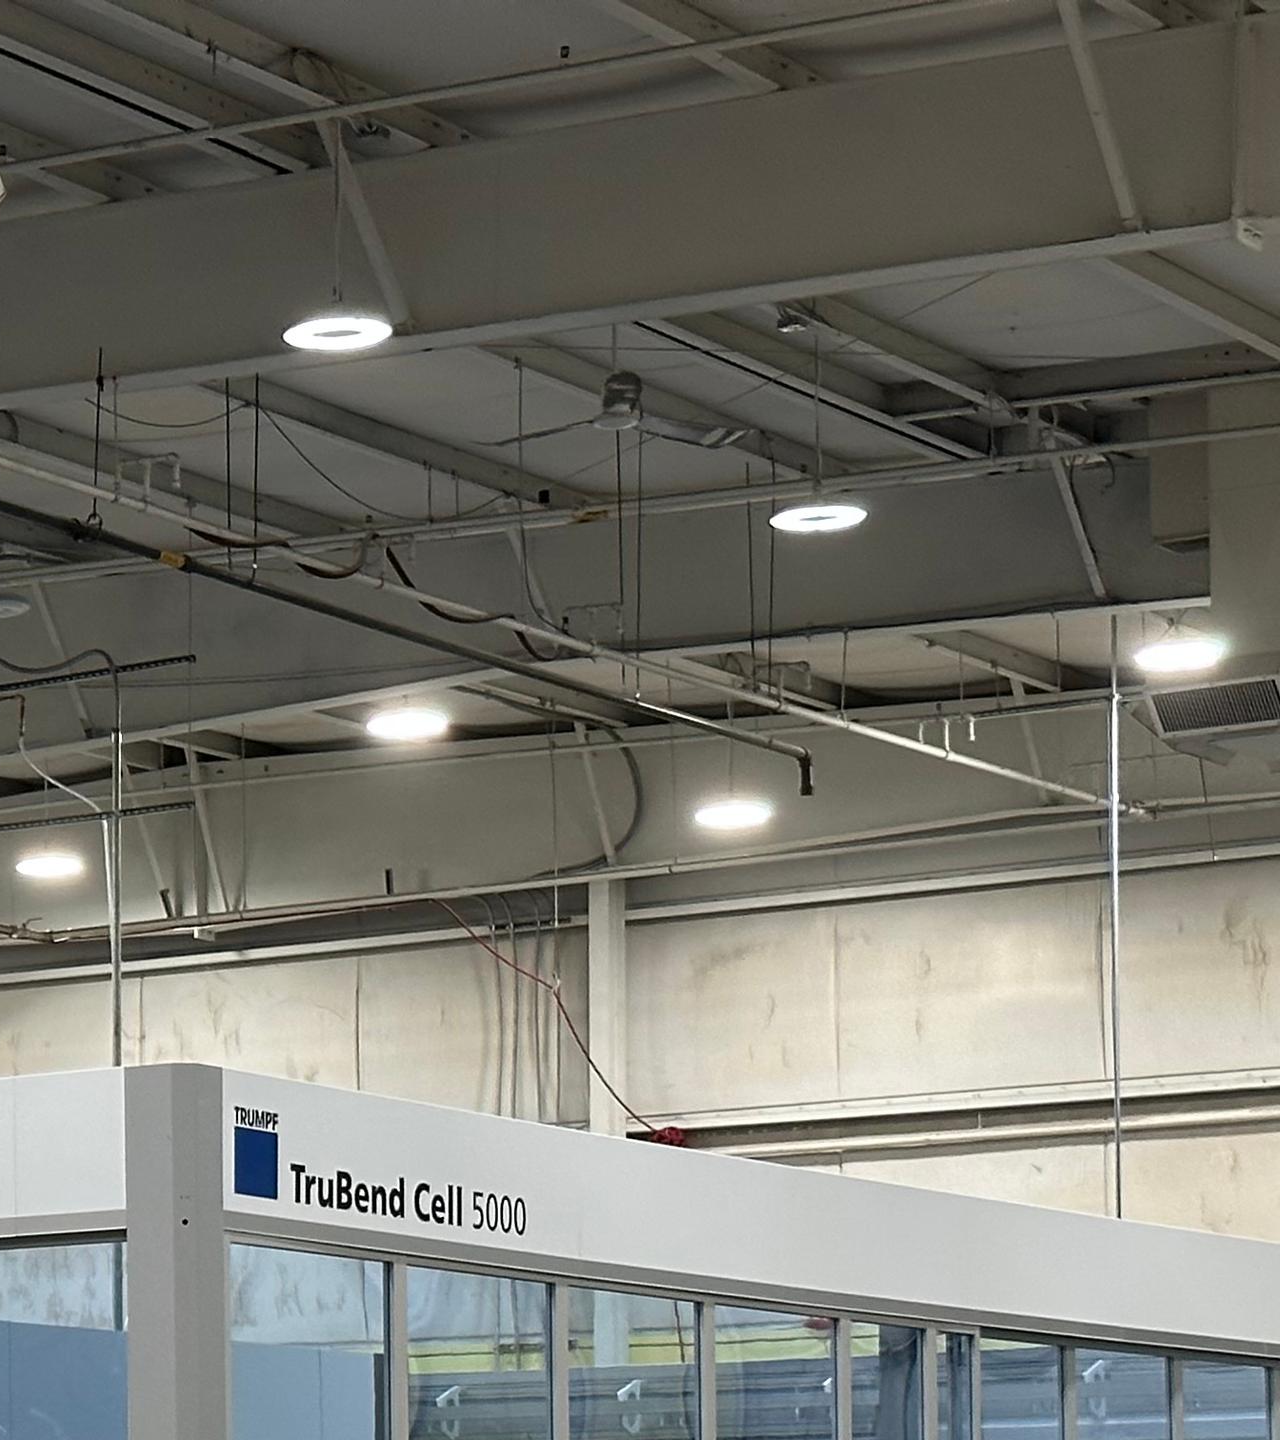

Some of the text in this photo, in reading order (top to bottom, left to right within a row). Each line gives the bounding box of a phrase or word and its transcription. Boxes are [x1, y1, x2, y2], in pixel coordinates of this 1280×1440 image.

[234, 1106, 279, 1130] TRUMPF
[290, 1163, 527, 1236] TruBend Cell 5000
